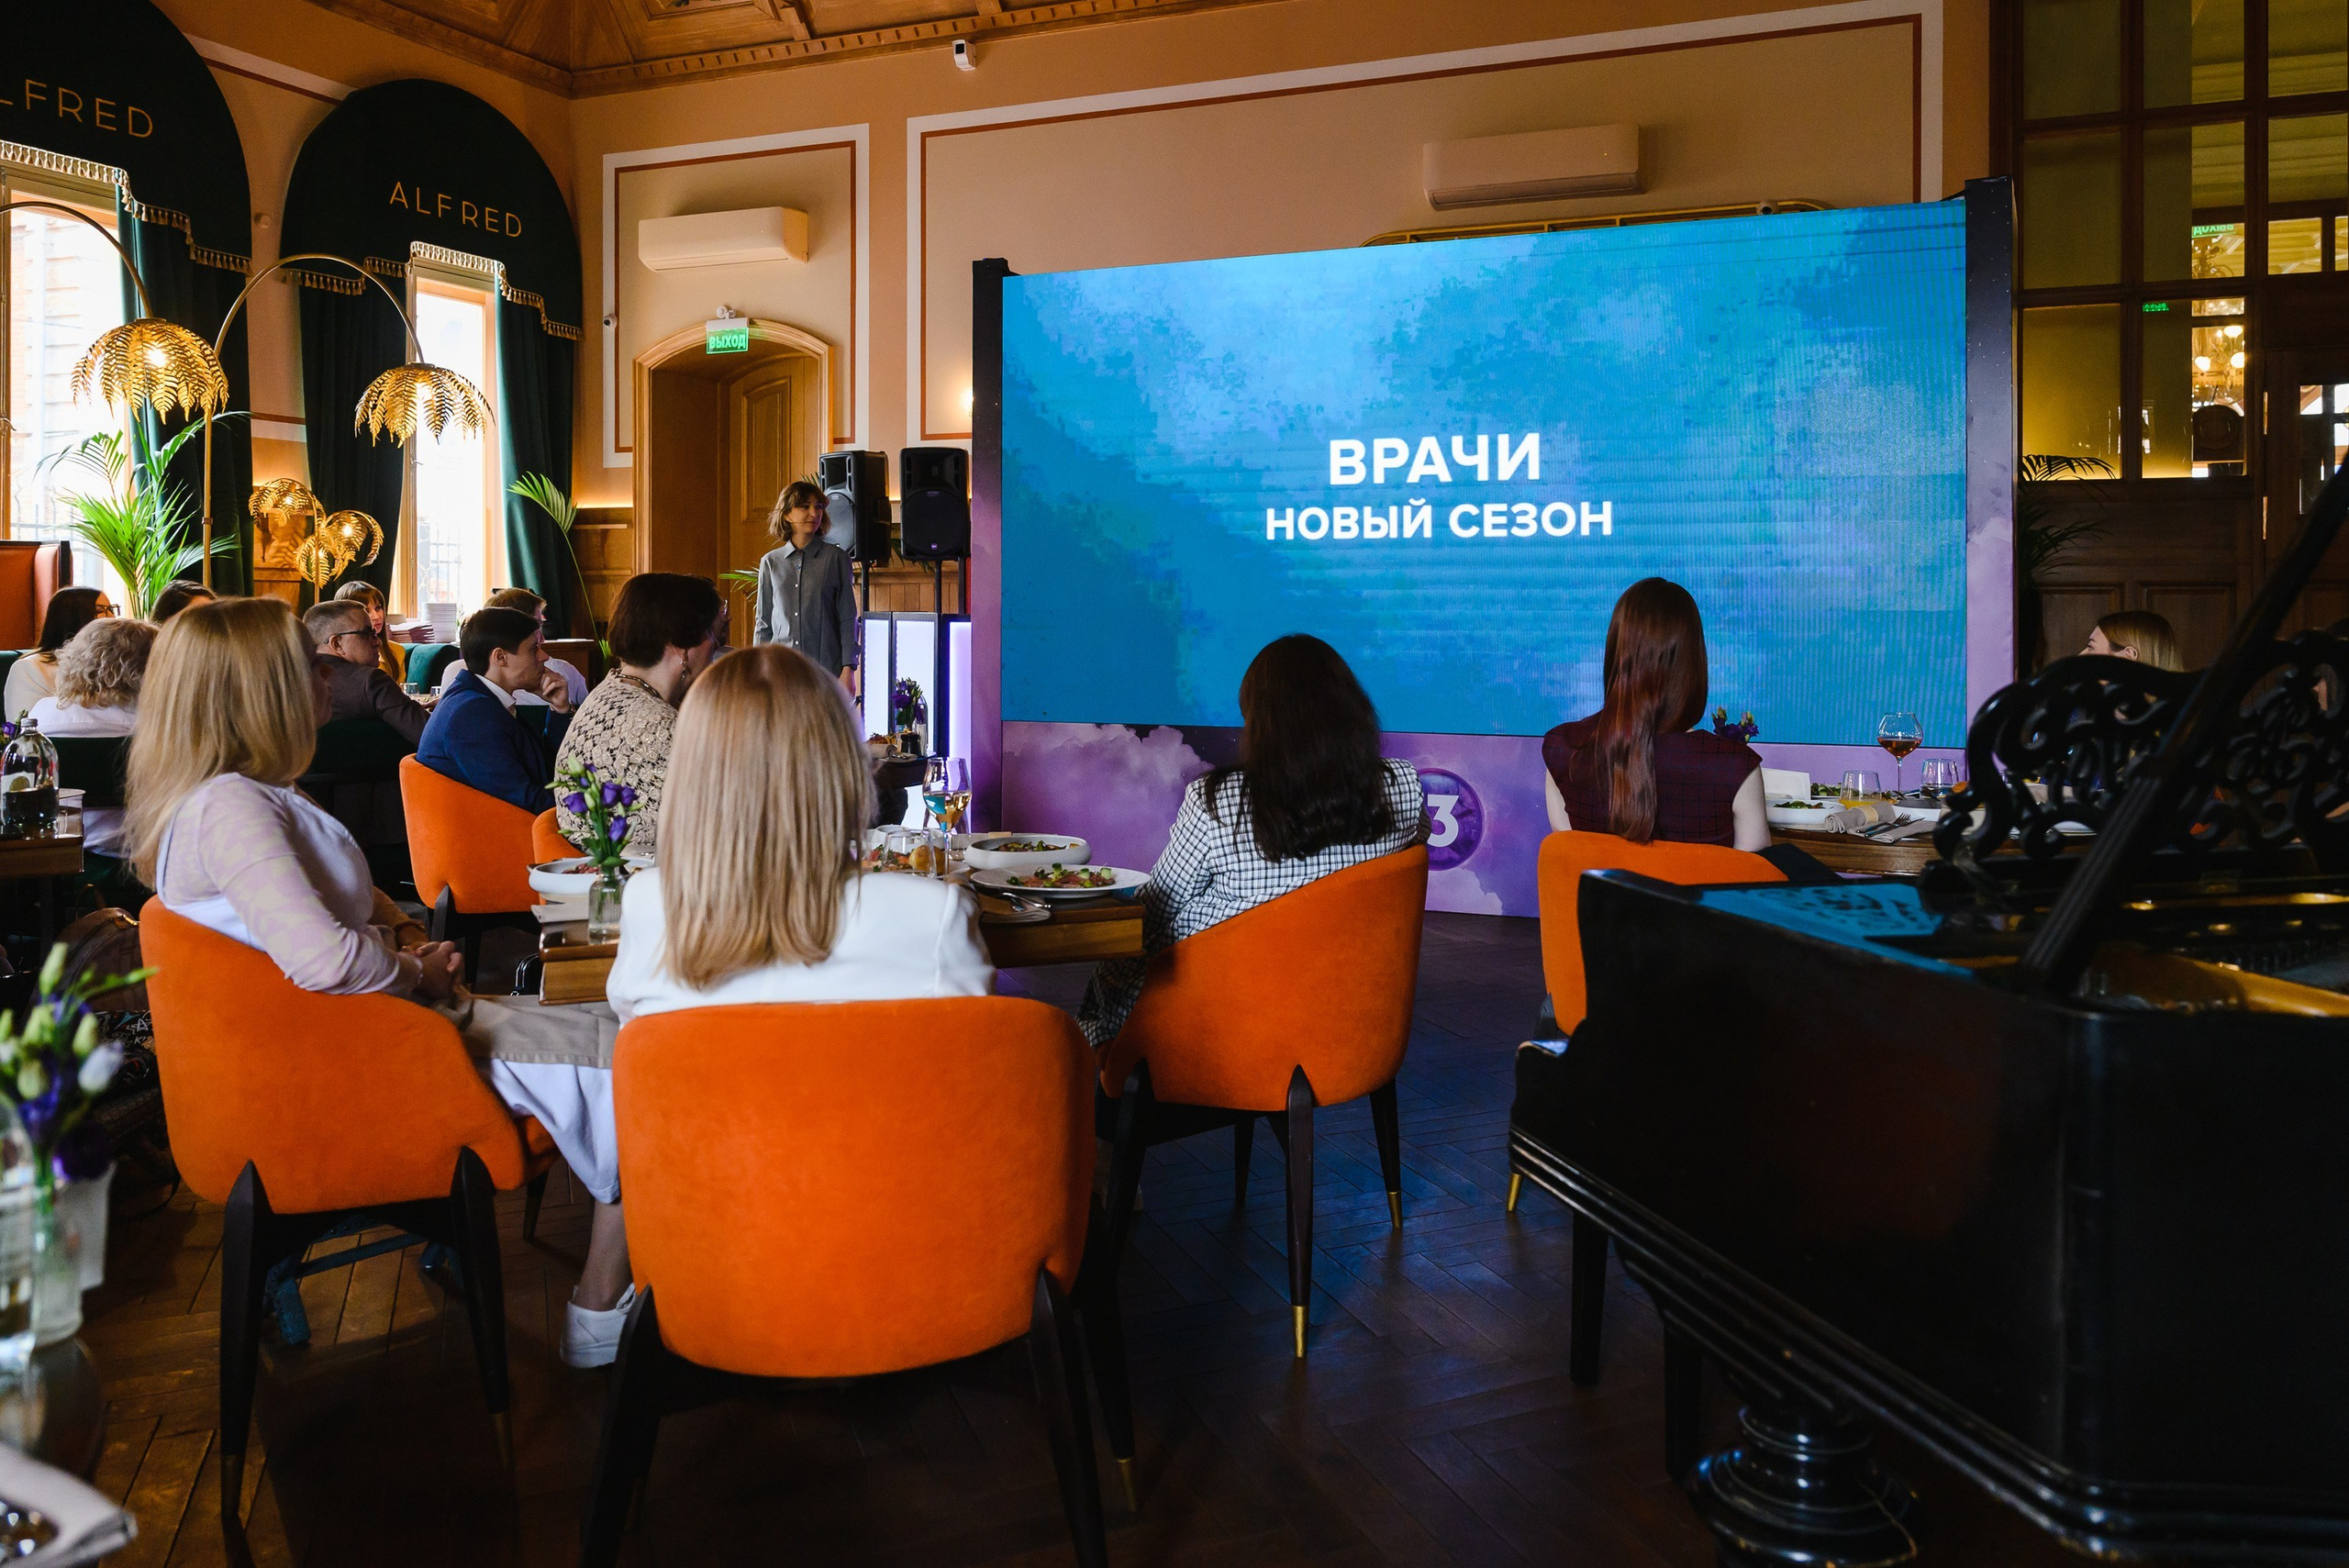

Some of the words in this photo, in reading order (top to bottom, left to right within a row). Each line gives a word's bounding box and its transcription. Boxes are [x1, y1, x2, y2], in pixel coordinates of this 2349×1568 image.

[389, 181, 522, 238] ALFRED
[708, 334, 746, 349] ВЫХОД
[1330, 432, 1541, 485] ВРАЧИ
[1265, 497, 1432, 540] НОВЫЙ
[1448, 500, 1612, 539] СЕЗОН
[1427, 794, 1460, 847] 3
